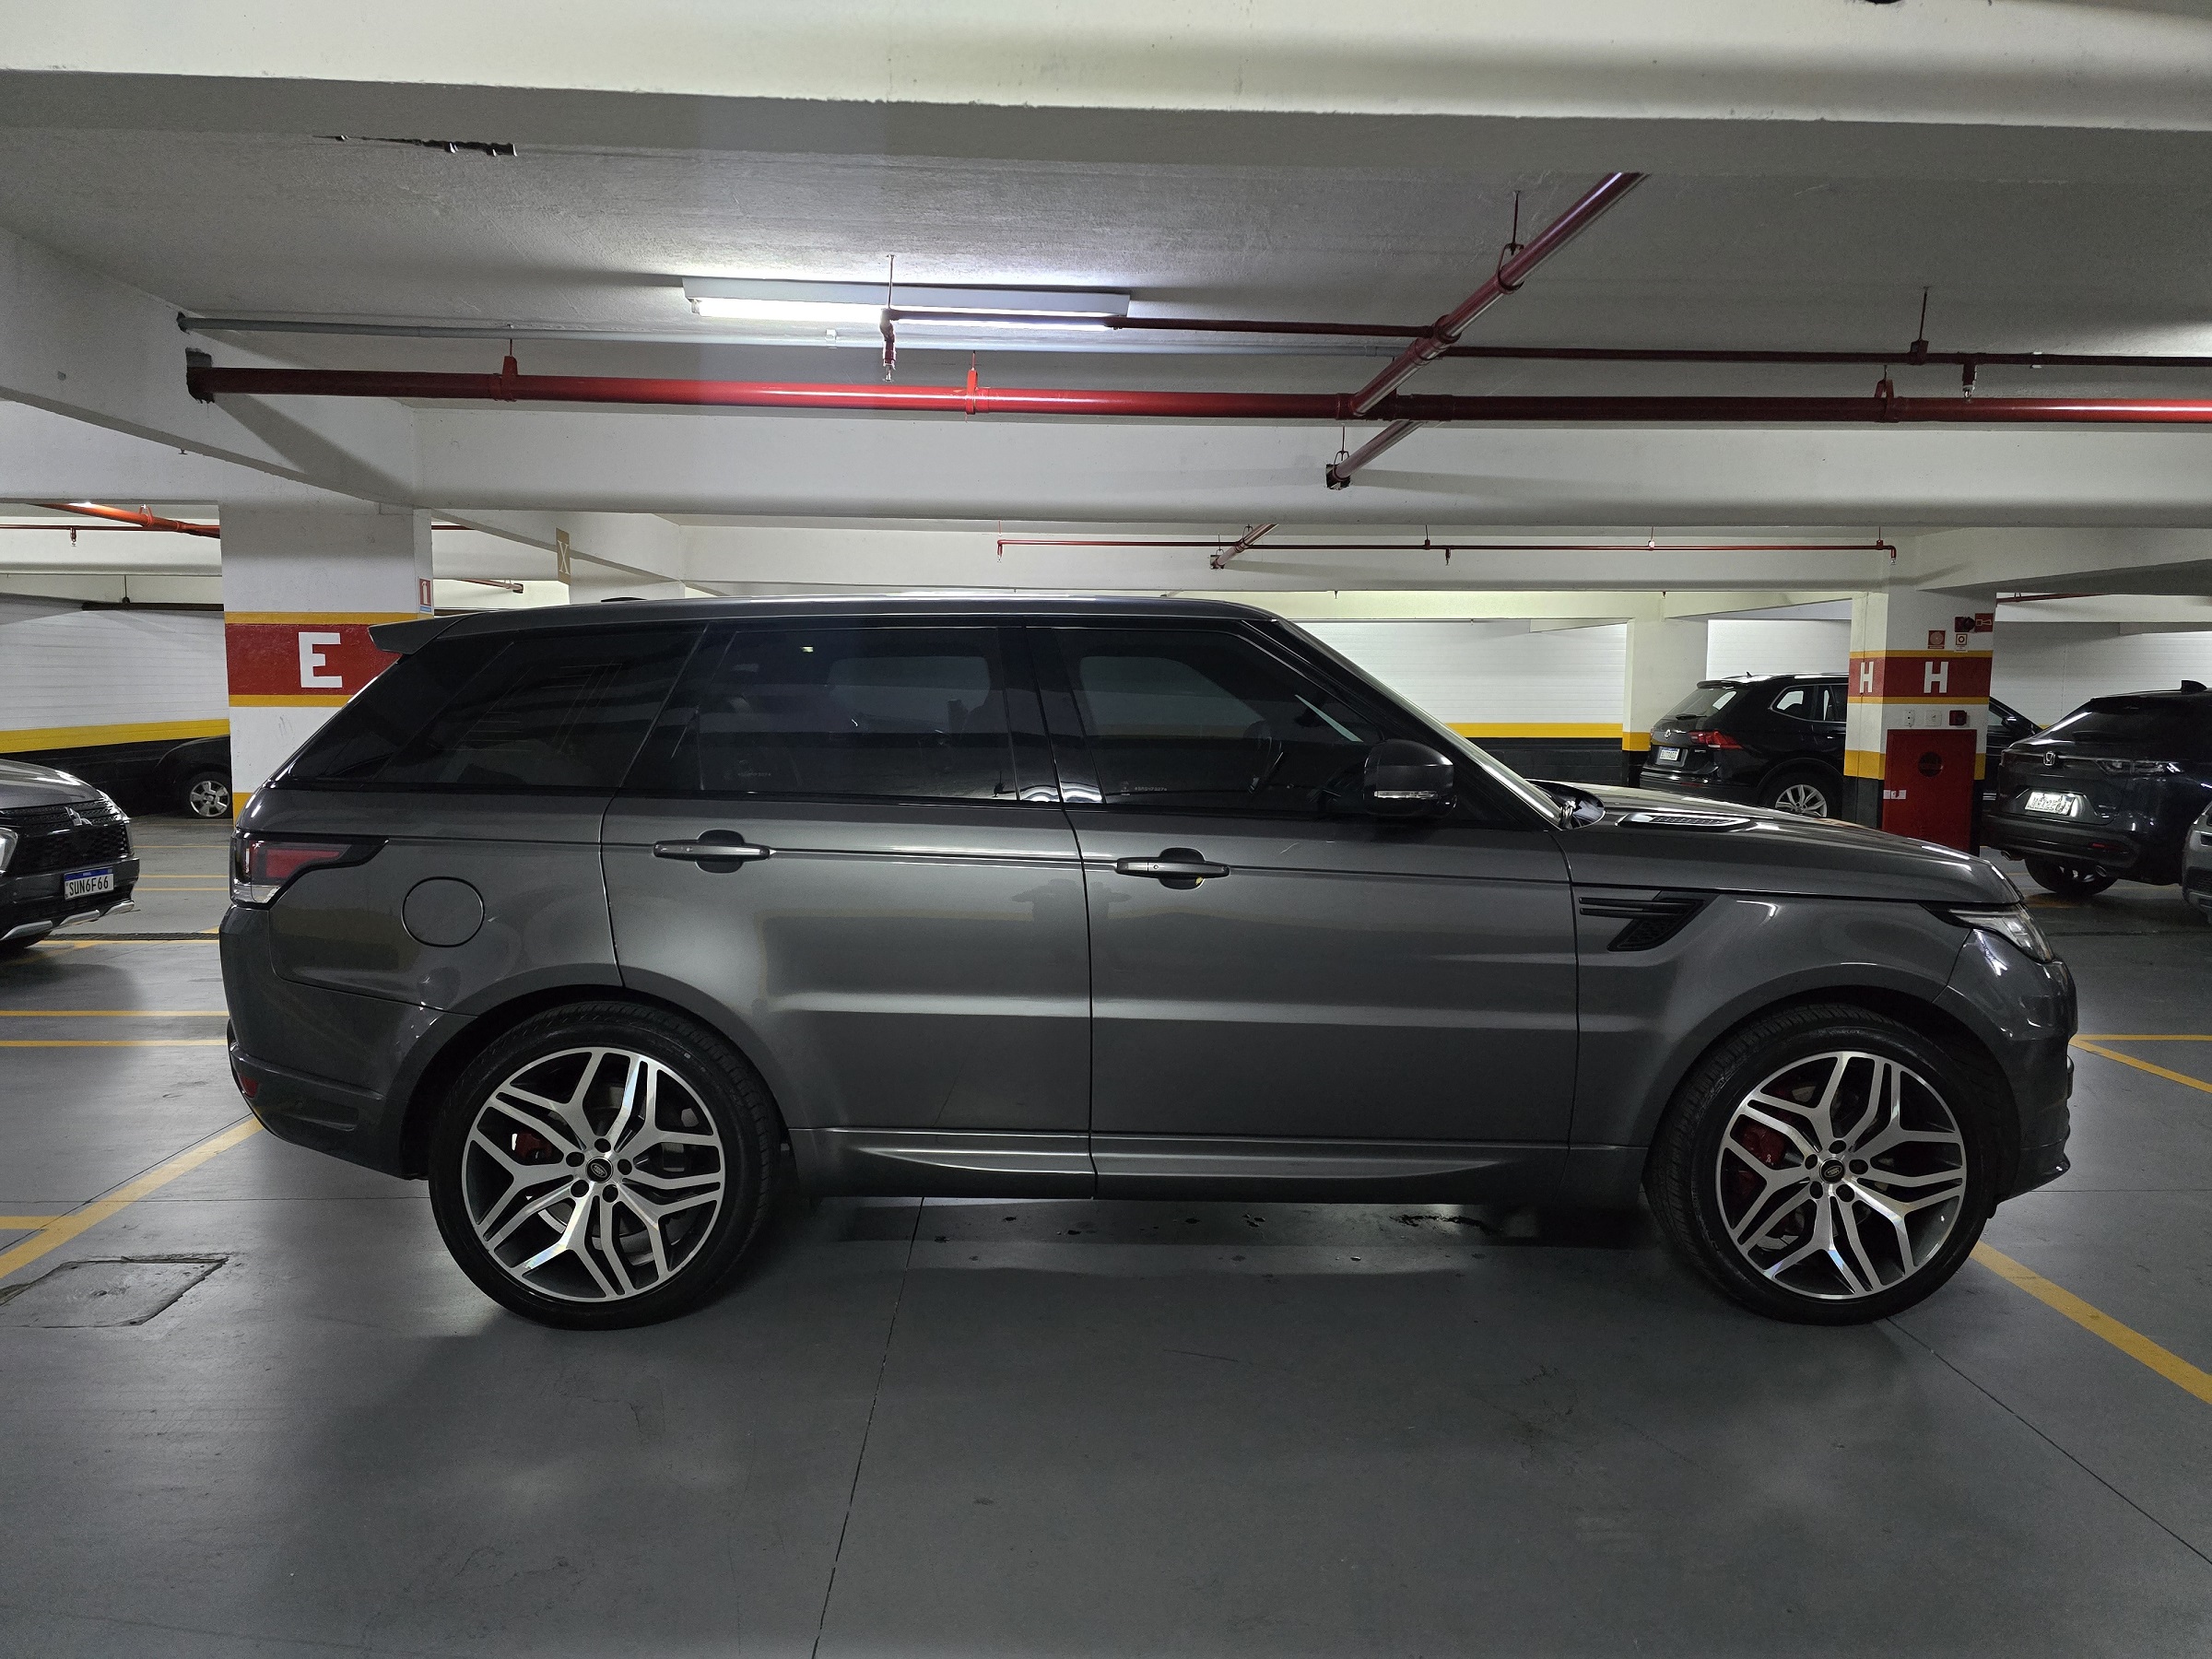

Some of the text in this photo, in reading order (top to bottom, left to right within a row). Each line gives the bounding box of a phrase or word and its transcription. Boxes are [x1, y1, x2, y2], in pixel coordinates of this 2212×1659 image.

[299, 632, 342, 688] E
[1860, 661, 1874, 693] H
[1924, 662, 1948, 693] H
[69, 876, 109, 896] SUN6F66
